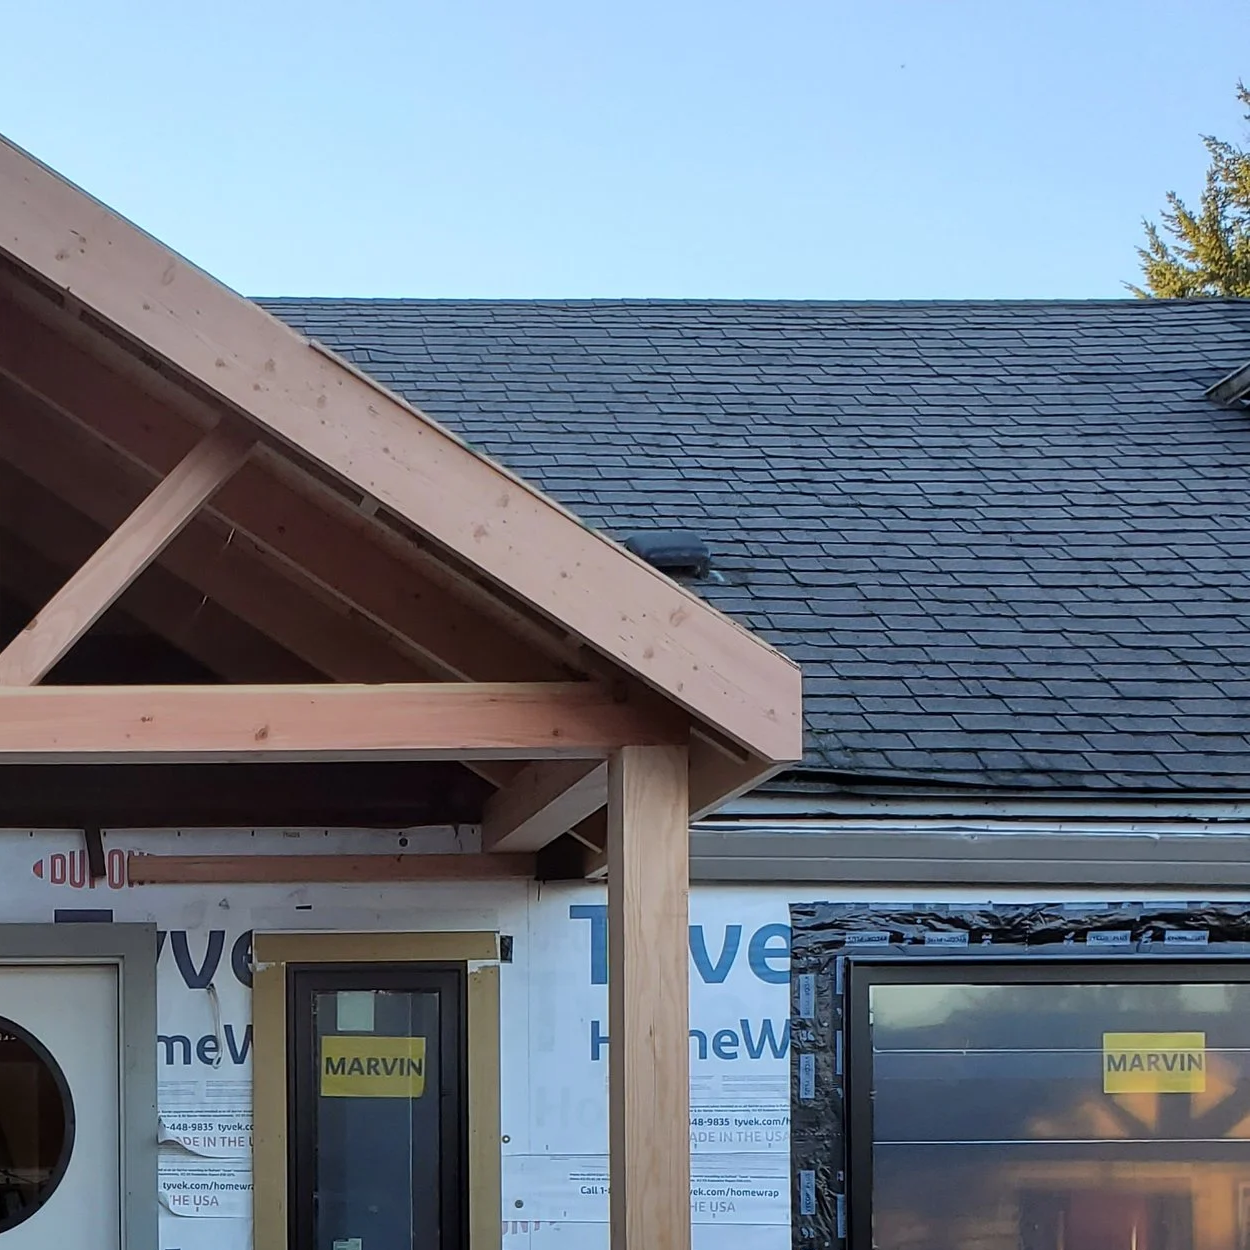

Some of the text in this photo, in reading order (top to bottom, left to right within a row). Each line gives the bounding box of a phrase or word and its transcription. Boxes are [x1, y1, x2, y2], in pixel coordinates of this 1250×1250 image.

[325, 1056, 423, 1076] MARVIN
[1107, 1053, 1203, 1072] MARVIN
[204, 1136, 216, 1147] IN
[220, 1136, 245, 1147] THE
[720, 1132, 732, 1142] IN
[737, 1131, 761, 1142] THE
[581, 1186, 597, 1195] Call
[193, 1195, 219, 1206] USA
[710, 1201, 735, 1213] USA
